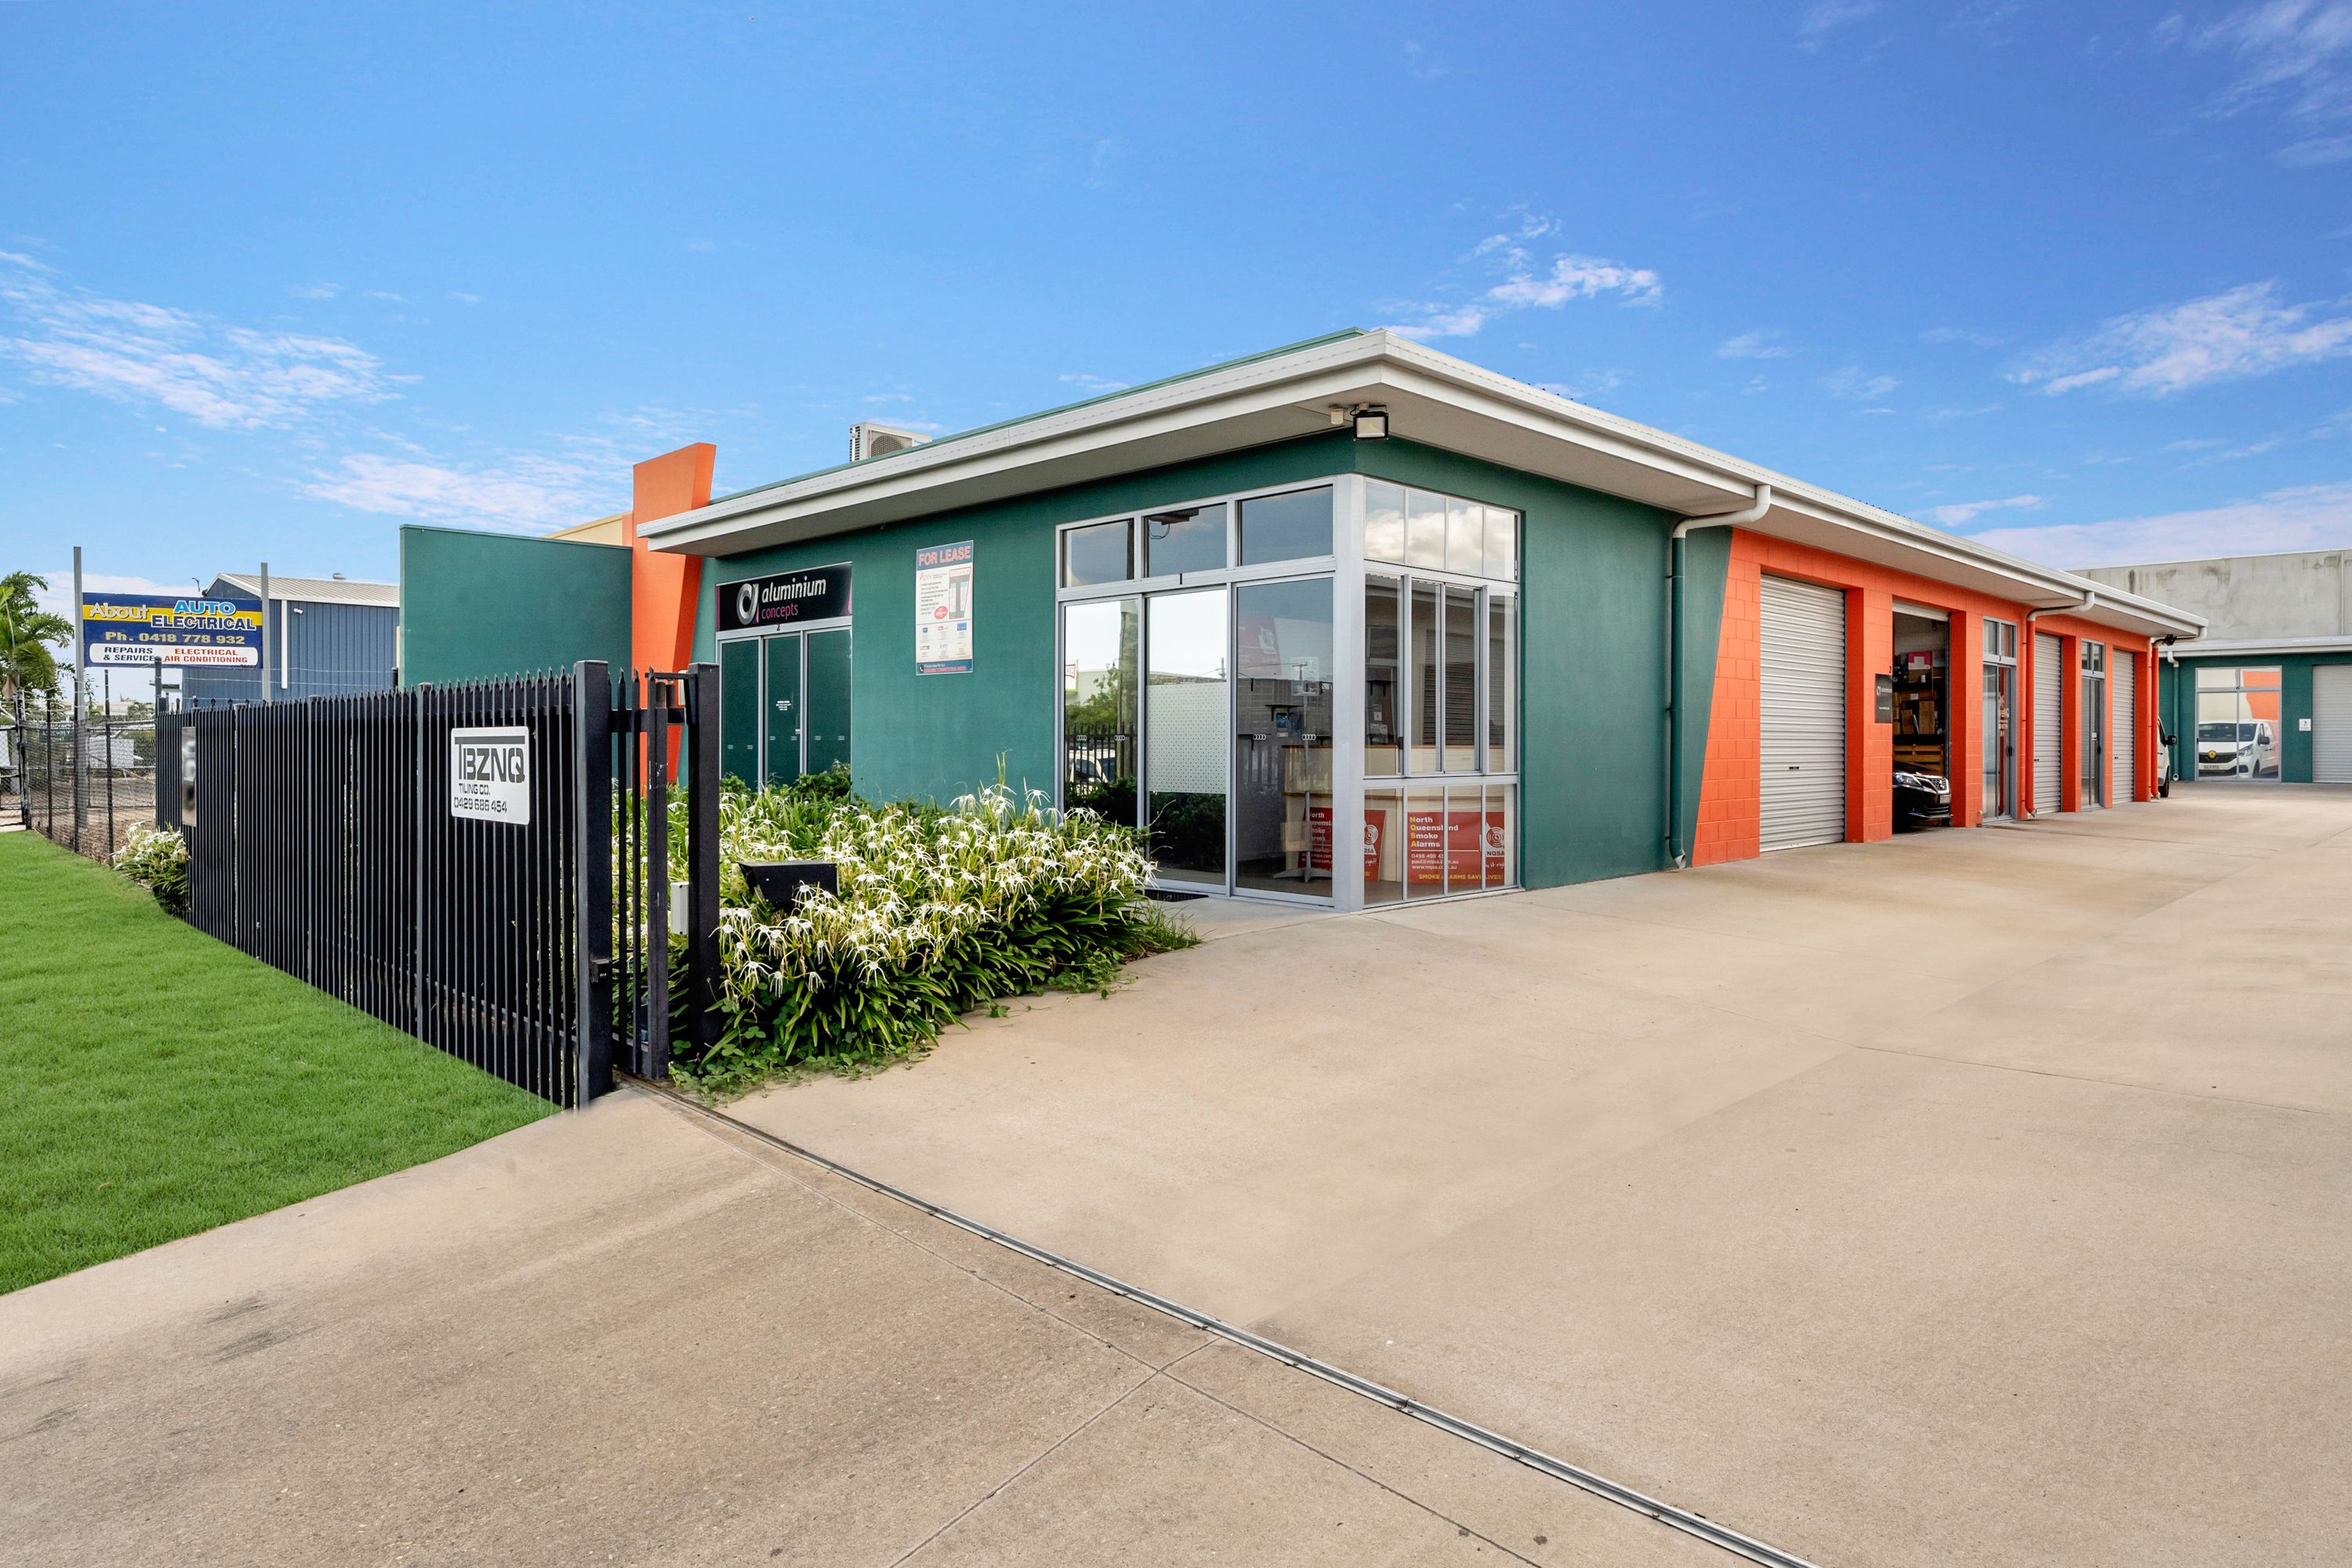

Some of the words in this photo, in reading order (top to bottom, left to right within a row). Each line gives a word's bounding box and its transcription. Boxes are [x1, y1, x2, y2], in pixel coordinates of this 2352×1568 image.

[919, 552, 938, 566] FOR
[940, 546, 971, 563] LEASE
[761, 575, 827, 603] aluminium
[89, 602, 149, 619] About
[174, 600, 236, 615] AUTO
[761, 603, 799, 620] concepts
[151, 614, 256, 631] ELECTRICAL
[105, 631, 134, 641] Ph.
[139, 633, 177, 642] 0418
[182, 633, 212, 643] 778
[216, 635, 245, 644] 932
[455, 735, 525, 783] TBZNQ
[459, 783, 479, 795] TILING
[479, 785, 491, 795] CO.
[454, 797, 474, 810] 0429
[474, 799, 490, 811] 686
[491, 800, 508, 813] 454
